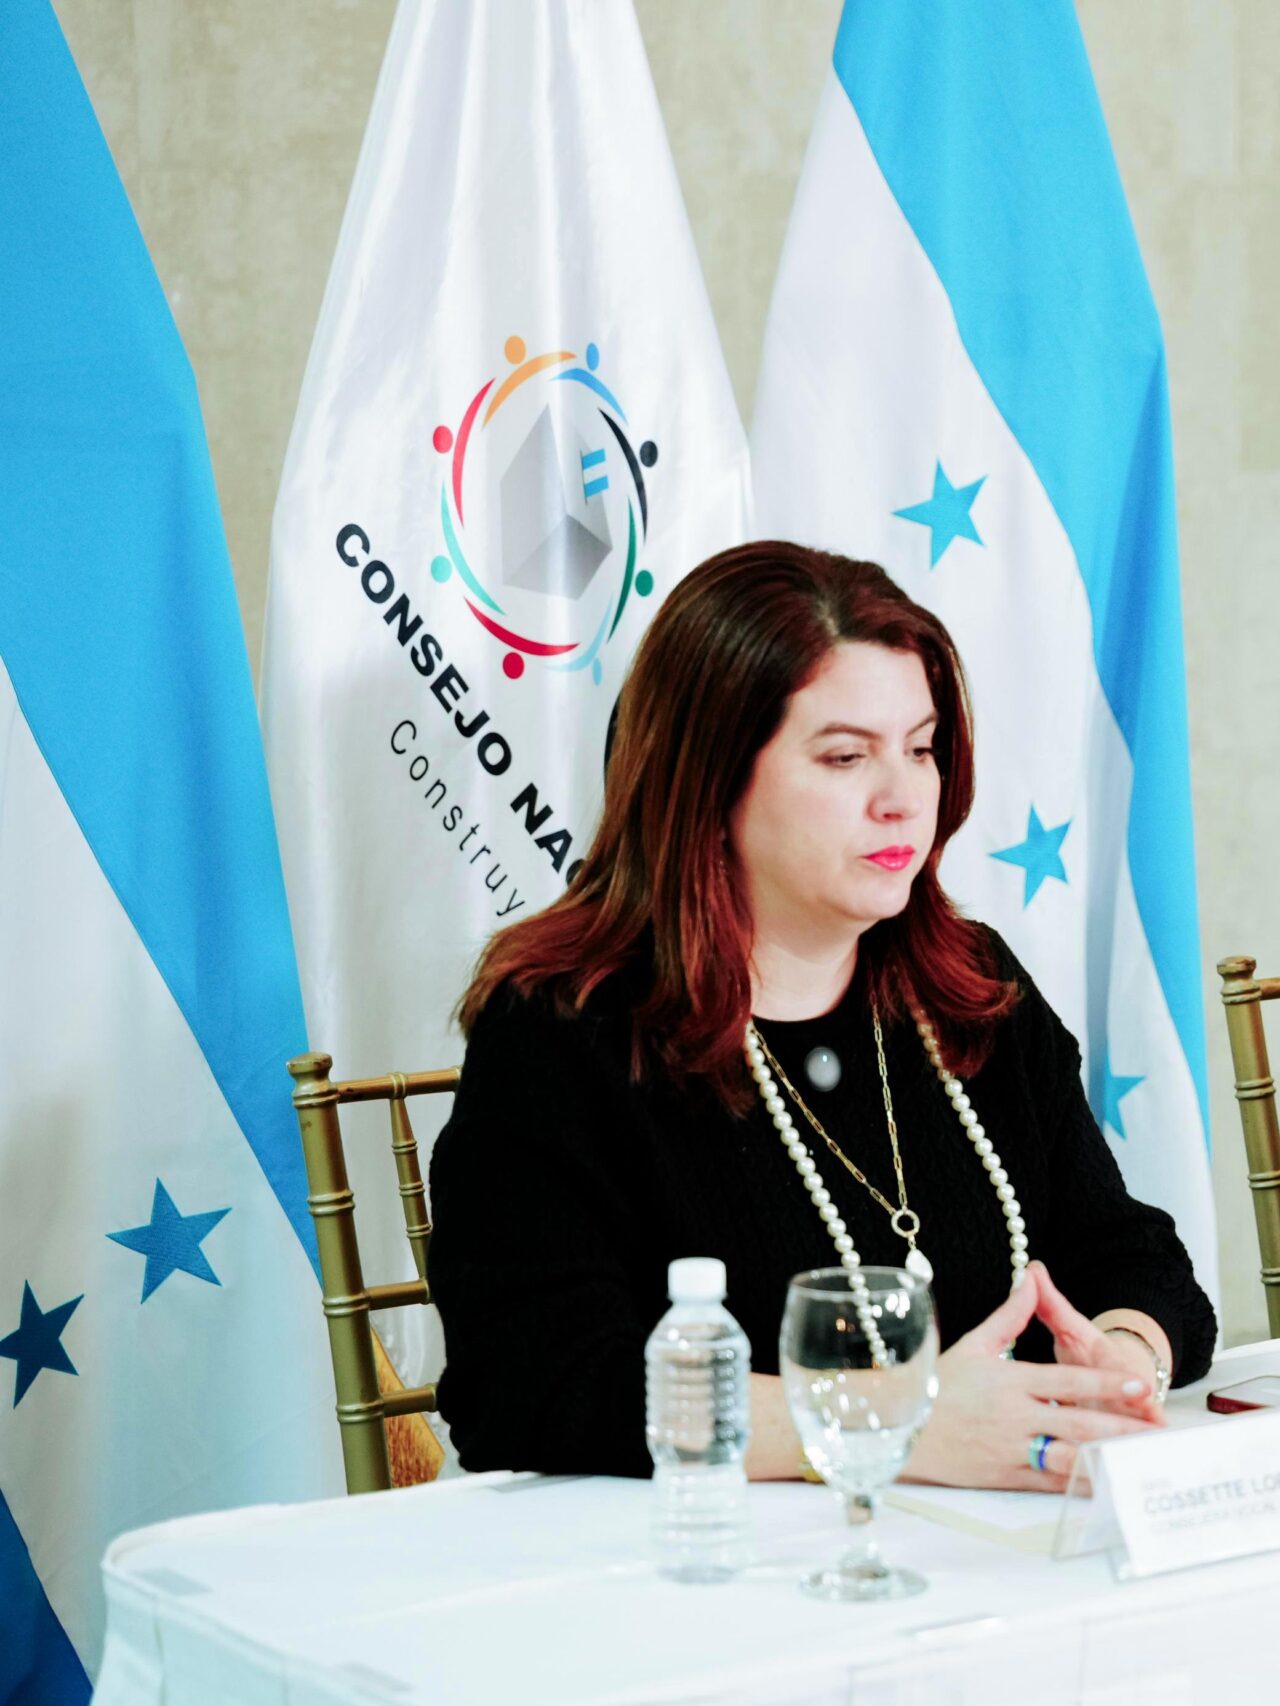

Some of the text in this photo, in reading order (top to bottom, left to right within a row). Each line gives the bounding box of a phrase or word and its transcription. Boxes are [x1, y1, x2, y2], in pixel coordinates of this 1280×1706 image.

[336, 523, 512, 777] CONSEJO
[390, 720, 525, 917] Construy
[1145, 1479, 1247, 1516] COSSETTE
